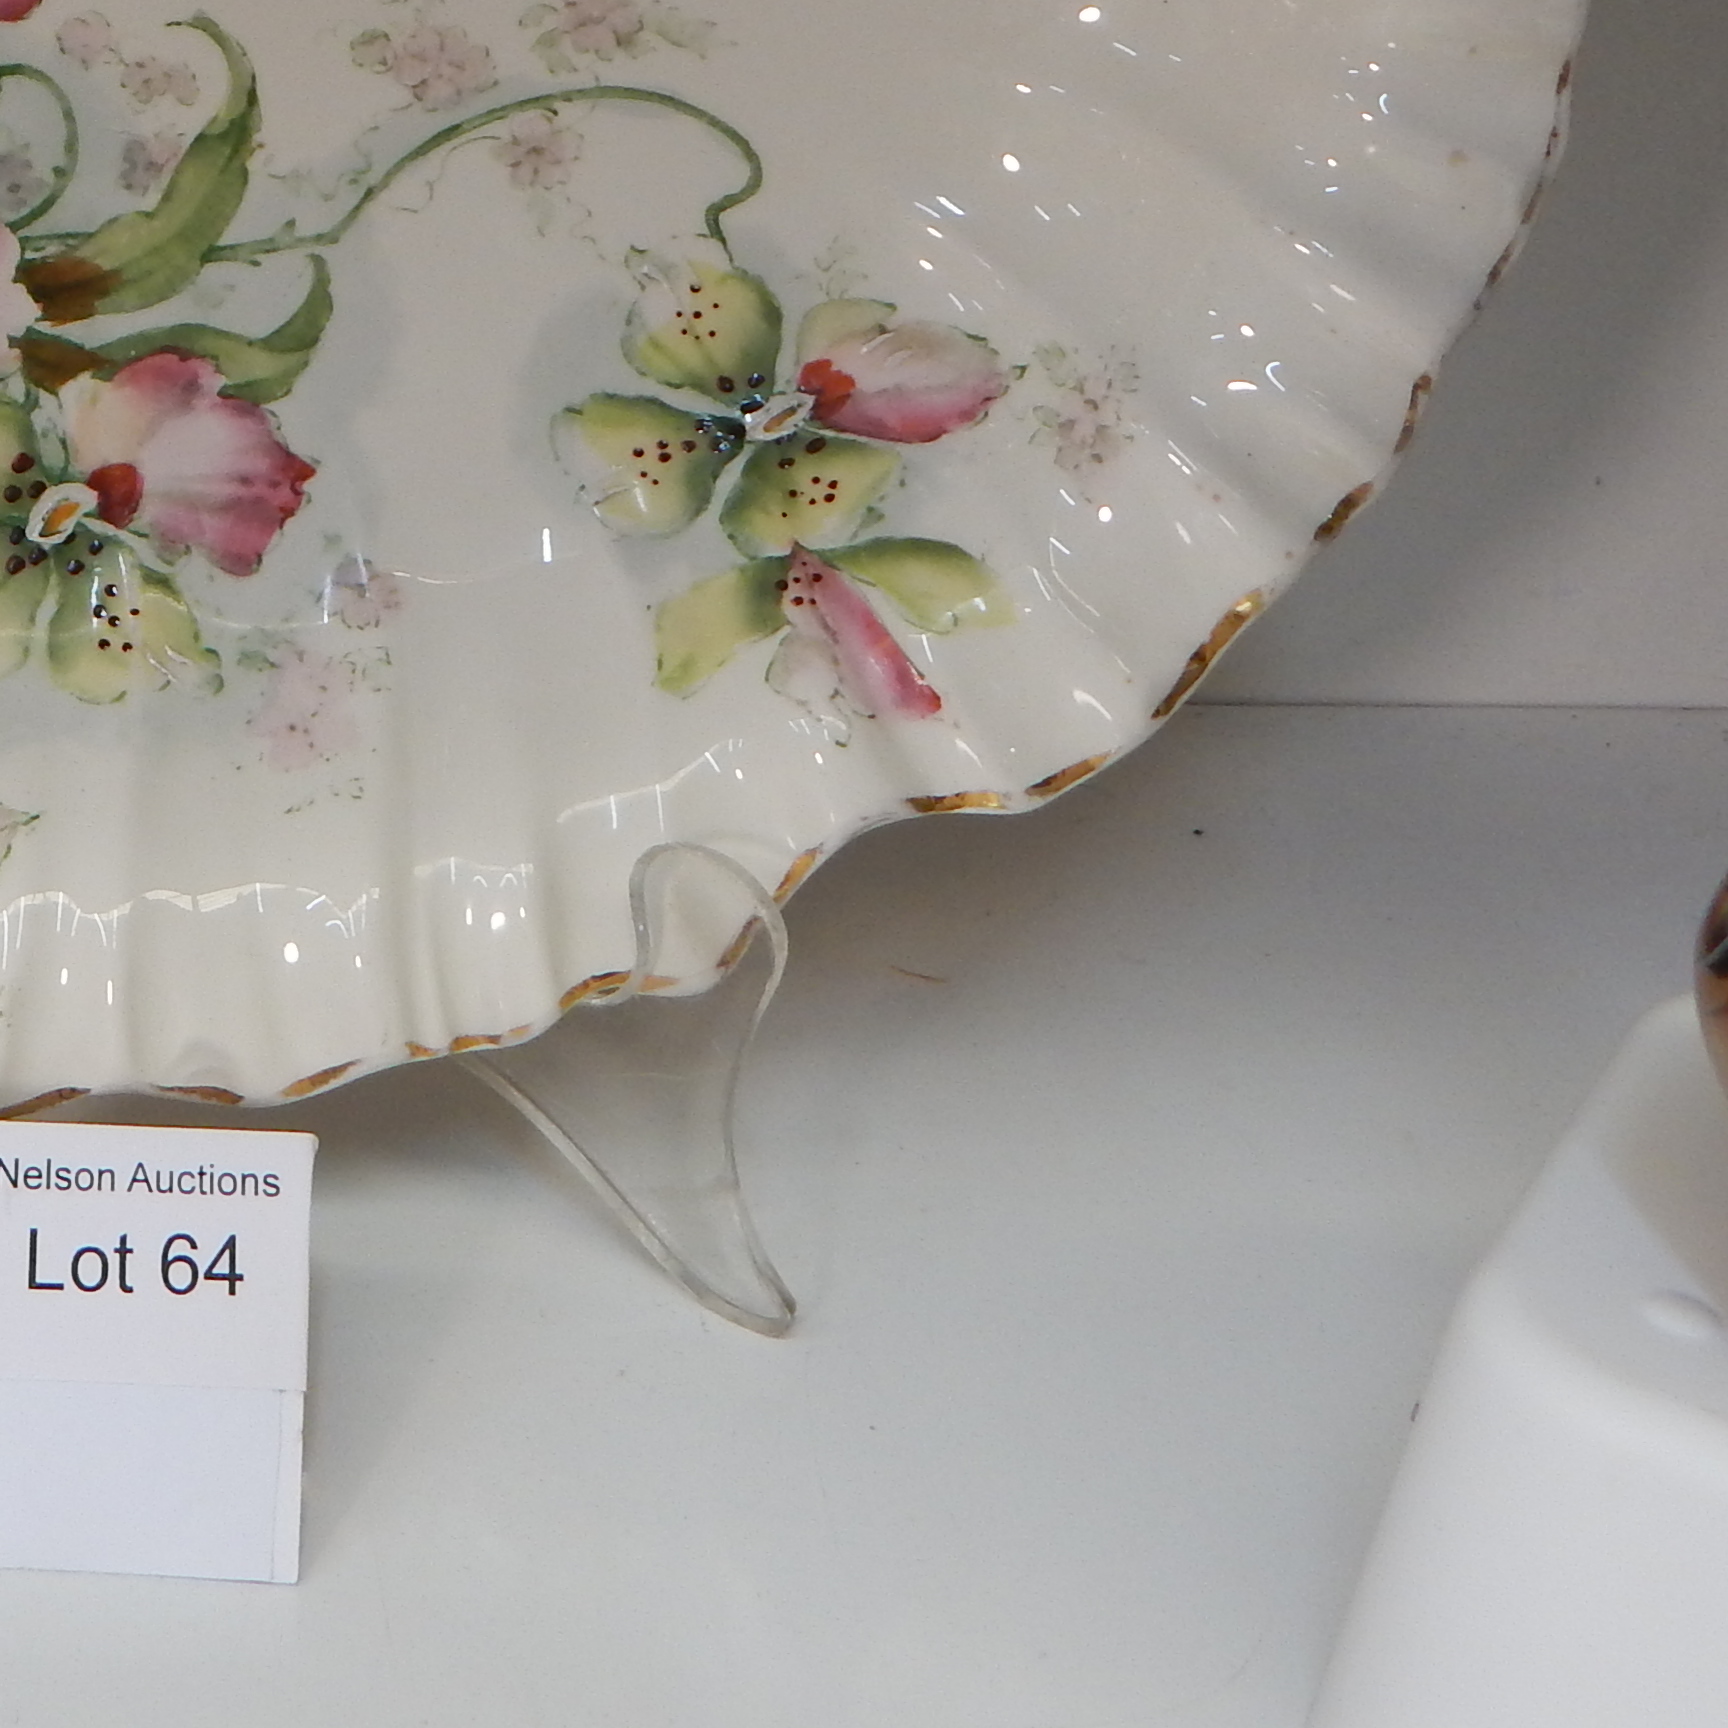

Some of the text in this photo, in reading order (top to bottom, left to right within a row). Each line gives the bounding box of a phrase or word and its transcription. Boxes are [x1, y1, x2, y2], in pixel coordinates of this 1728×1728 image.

[127, 1162, 281, 1197] Auctions
[27, 1228, 244, 1296] Lot 64
